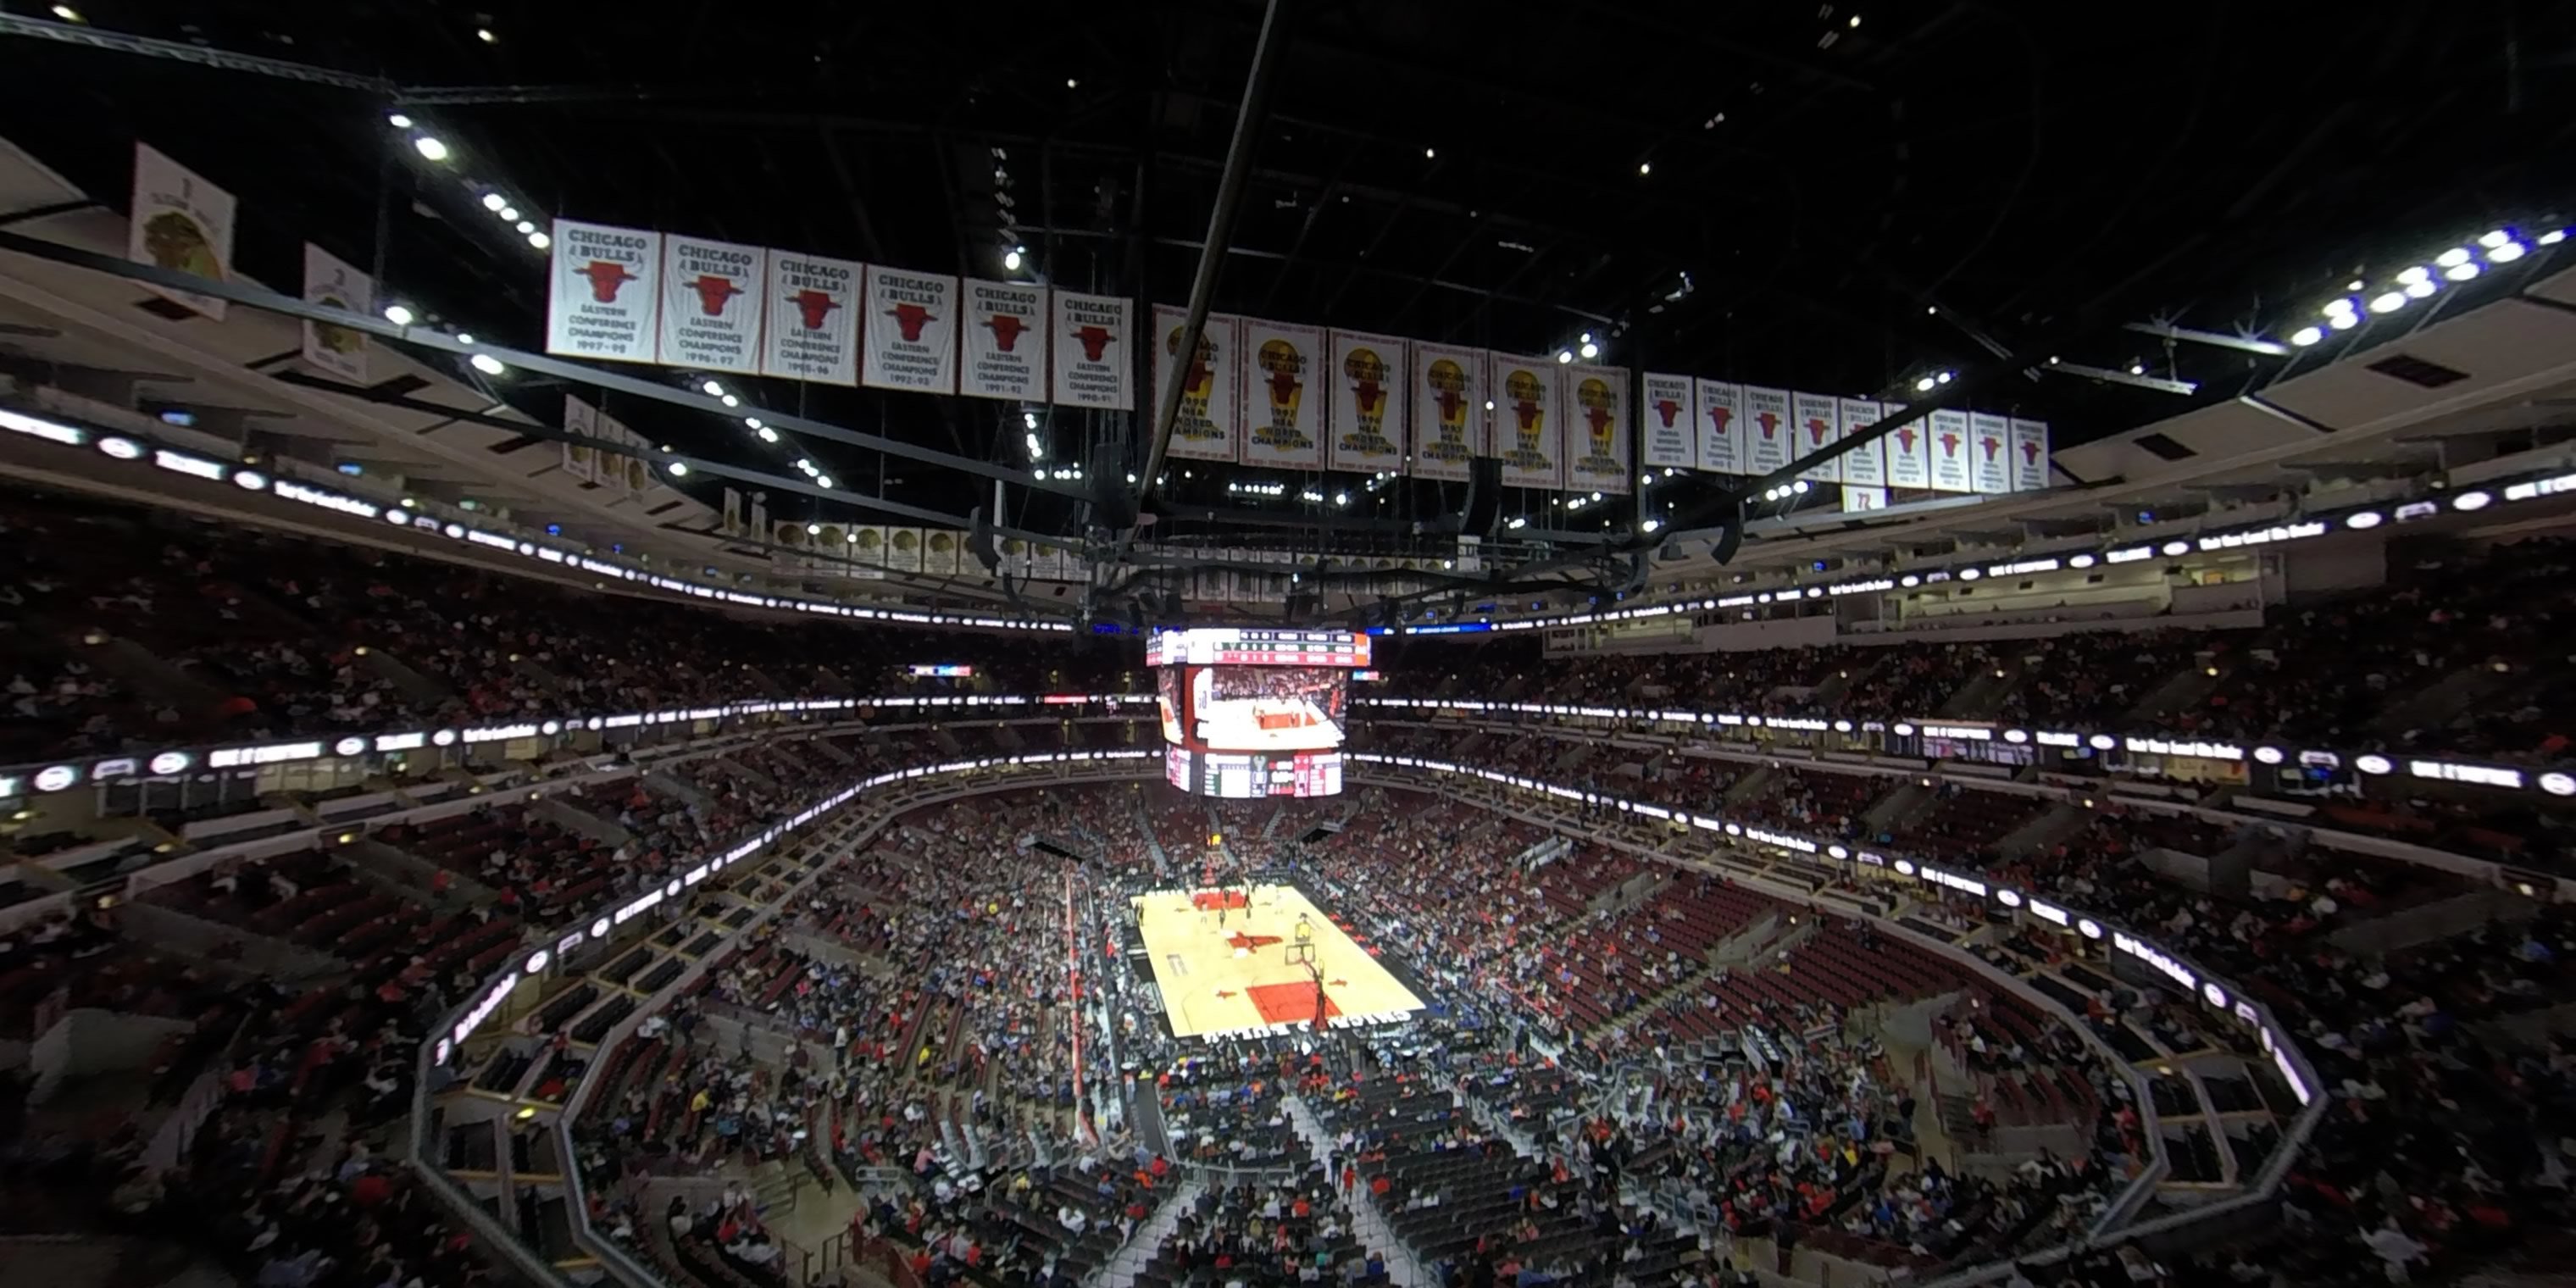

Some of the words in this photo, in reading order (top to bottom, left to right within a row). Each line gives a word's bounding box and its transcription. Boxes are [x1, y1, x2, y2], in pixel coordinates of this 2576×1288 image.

[568, 229, 647, 250] CHICAGO
[580, 246, 635, 263] BULLS
[678, 244, 752, 266] CHICAGO
[690, 260, 741, 277] BULLS
[780, 259, 849, 280] CHICAGO
[791, 274, 840, 291] BULLS
[879, 274, 944, 293] CHICAGO
[888, 288, 935, 304] BULLS
[975, 286, 1036, 303] CHICAGO
[580, 304, 627, 317] EASTERN
[985, 301, 1028, 314] BULLS
[1064, 299, 1123, 315] CHICAGO
[569, 314, 636, 330] CONFERENCE
[690, 317, 735, 330] EASTERN
[1074, 312, 1114, 325] BULLS
[568, 327, 634, 342] CHAMPIONS
[679, 327, 743, 343] CONFERENCE
[791, 327, 832, 341] EASTERN
[679, 339, 741, 355] CHAMPIONS
[780, 338, 841, 353] CONFERENCE
[891, 341, 930, 353] EASTERN
[780, 349, 839, 365] CHAMPIONS
[881, 351, 939, 365] CONFERENCE
[985, 352, 1022, 363] EASTERN
[1261, 350, 1307, 364] CHICAGO
[882, 363, 938, 376] CHAMPIONS
[977, 362, 1030, 375] CONFERENCE
[1076, 362, 1110, 373] EASTERN
[978, 372, 1029, 385] CHAMPIONS
[1068, 370, 1118, 383] CONFERENCE
[1069, 382, 1118, 393] CHAMPIONS
[1647, 379, 1686, 390] CHICAGO
[1174, 428, 1225, 440] AMPIONS
[1265, 427, 1302, 437] WORLD
[1252, 436, 1313, 448] CHAMPIONS
[1339, 443, 1397, 455] CHAMPIONS
[1422, 452, 1474, 461] CHAMPION
